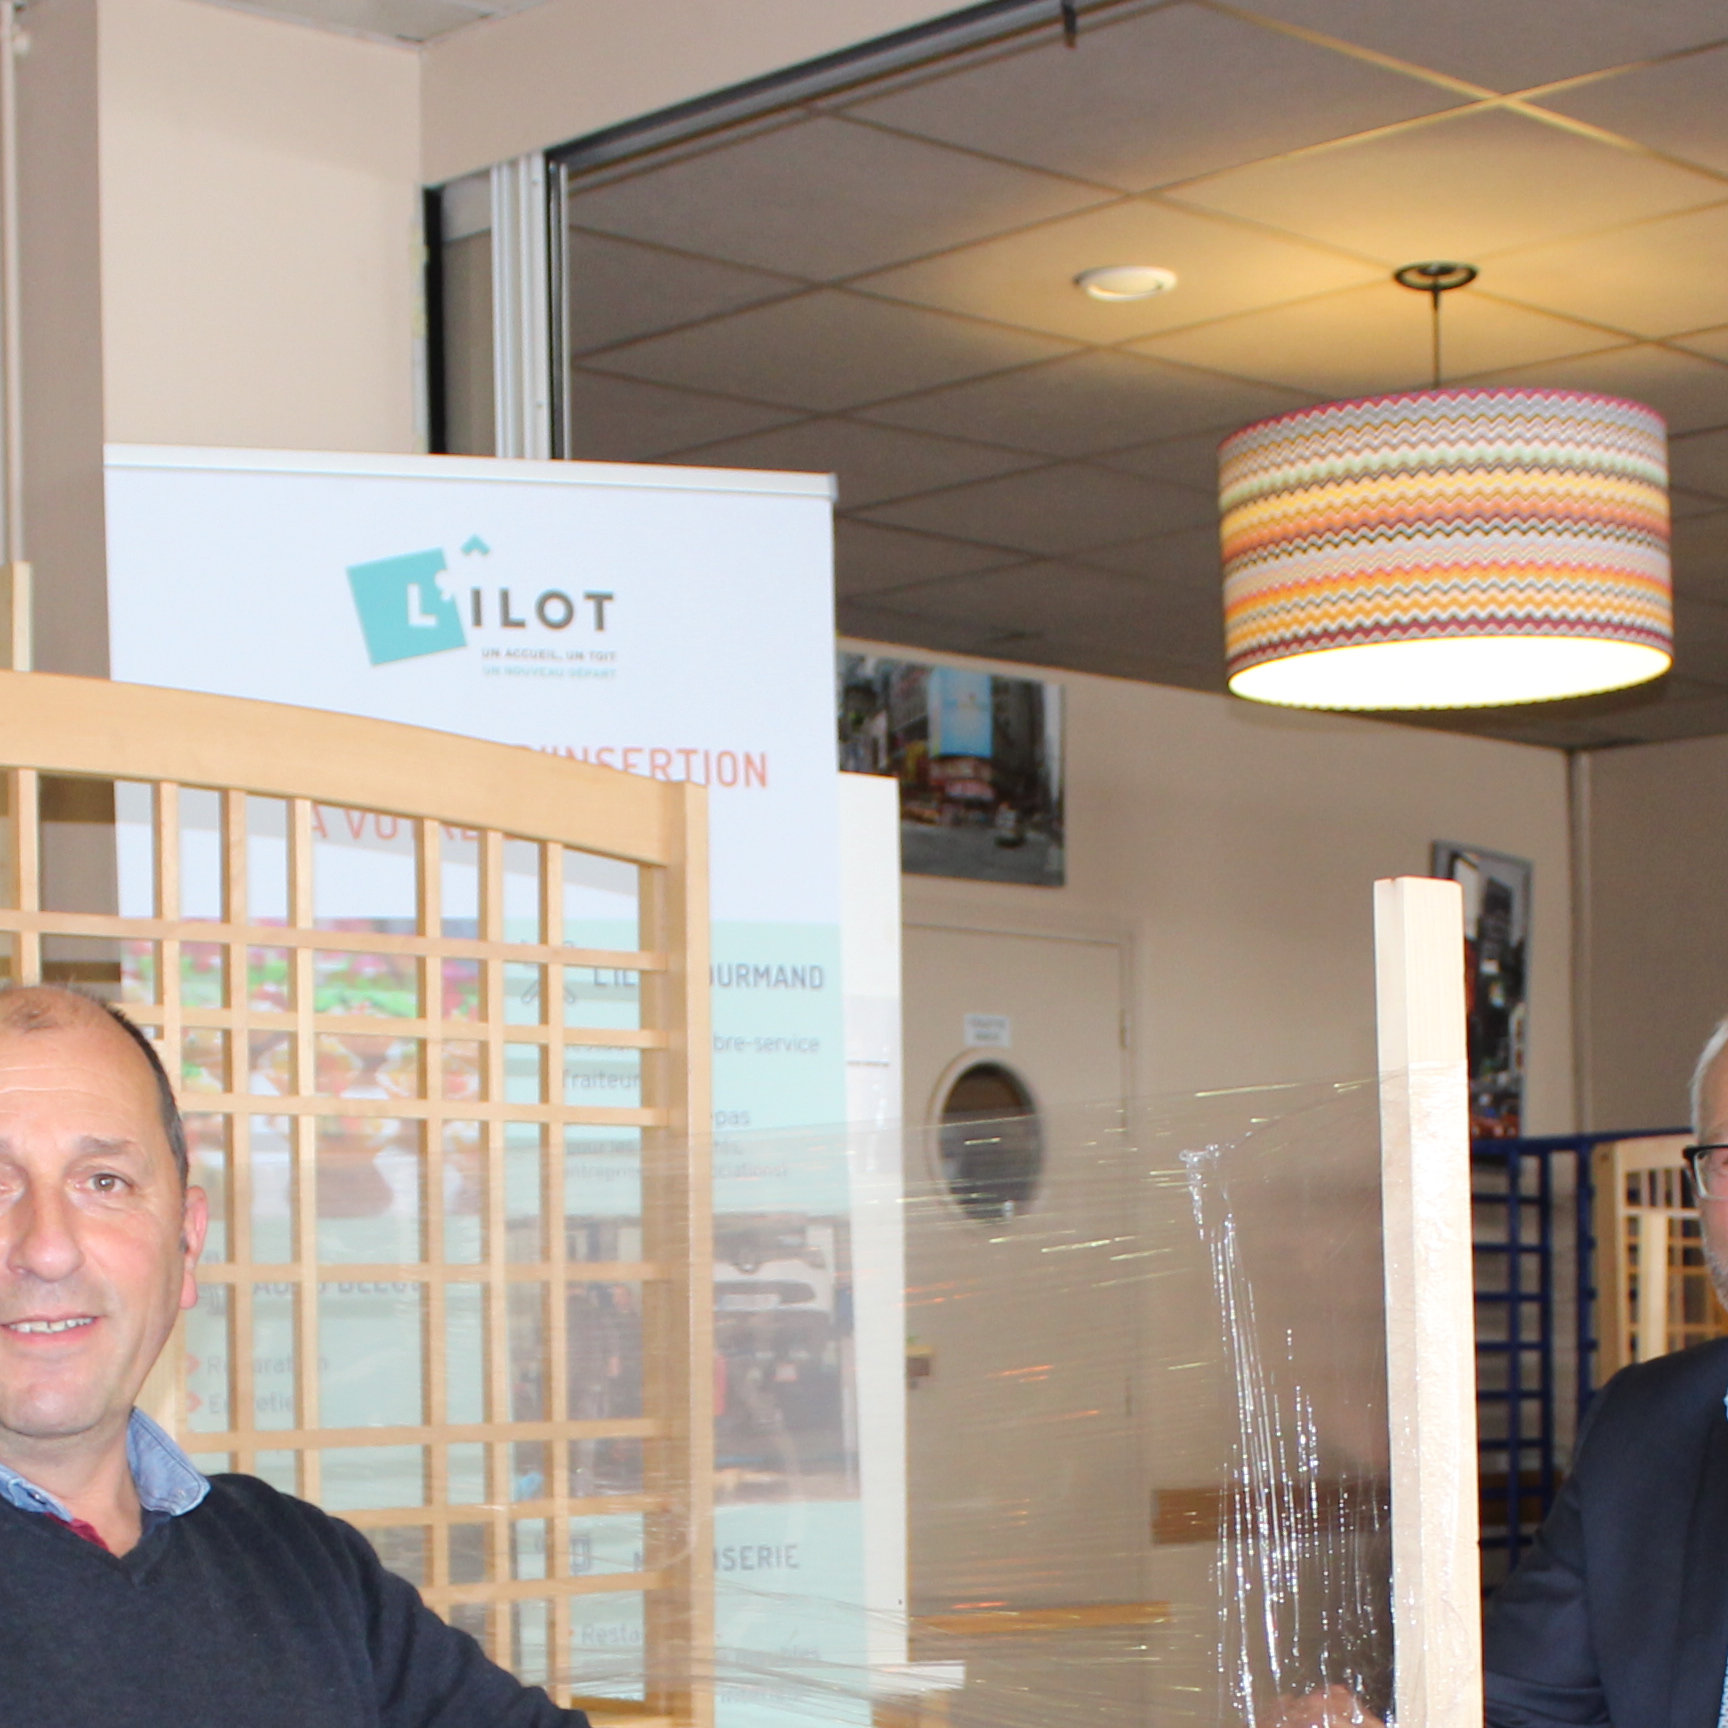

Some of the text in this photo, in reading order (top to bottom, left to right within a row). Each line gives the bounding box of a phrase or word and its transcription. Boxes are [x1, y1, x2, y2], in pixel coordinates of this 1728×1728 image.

[481, 648, 500, 659] UN
[565, 651, 584, 661] UN
[589, 651, 617, 662] TOIT
[482, 665, 500, 675] UN
[504, 666, 564, 677] NOUVEAU
